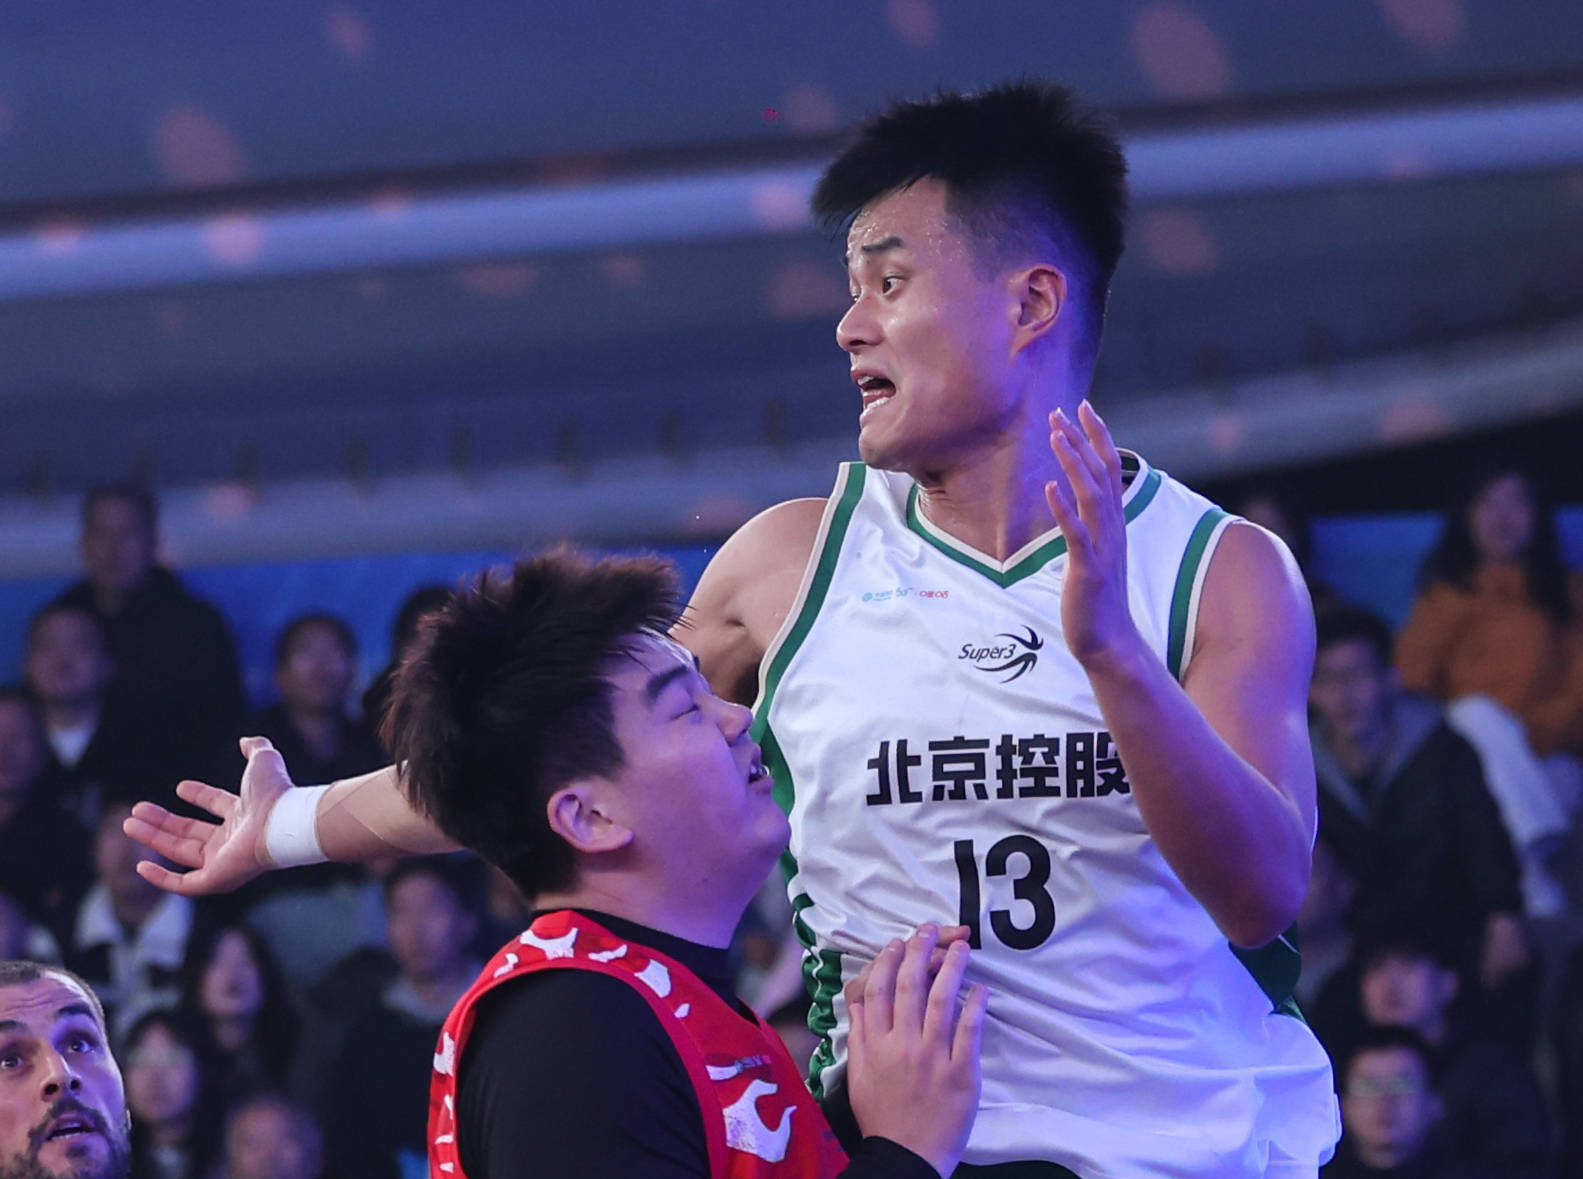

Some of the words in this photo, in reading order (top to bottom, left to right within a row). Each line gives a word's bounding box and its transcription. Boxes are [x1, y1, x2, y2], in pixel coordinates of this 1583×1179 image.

[958, 643, 1017, 662] Super3
[866, 731, 1131, 806] 北京控股
[954, 834, 1056, 951] 13
